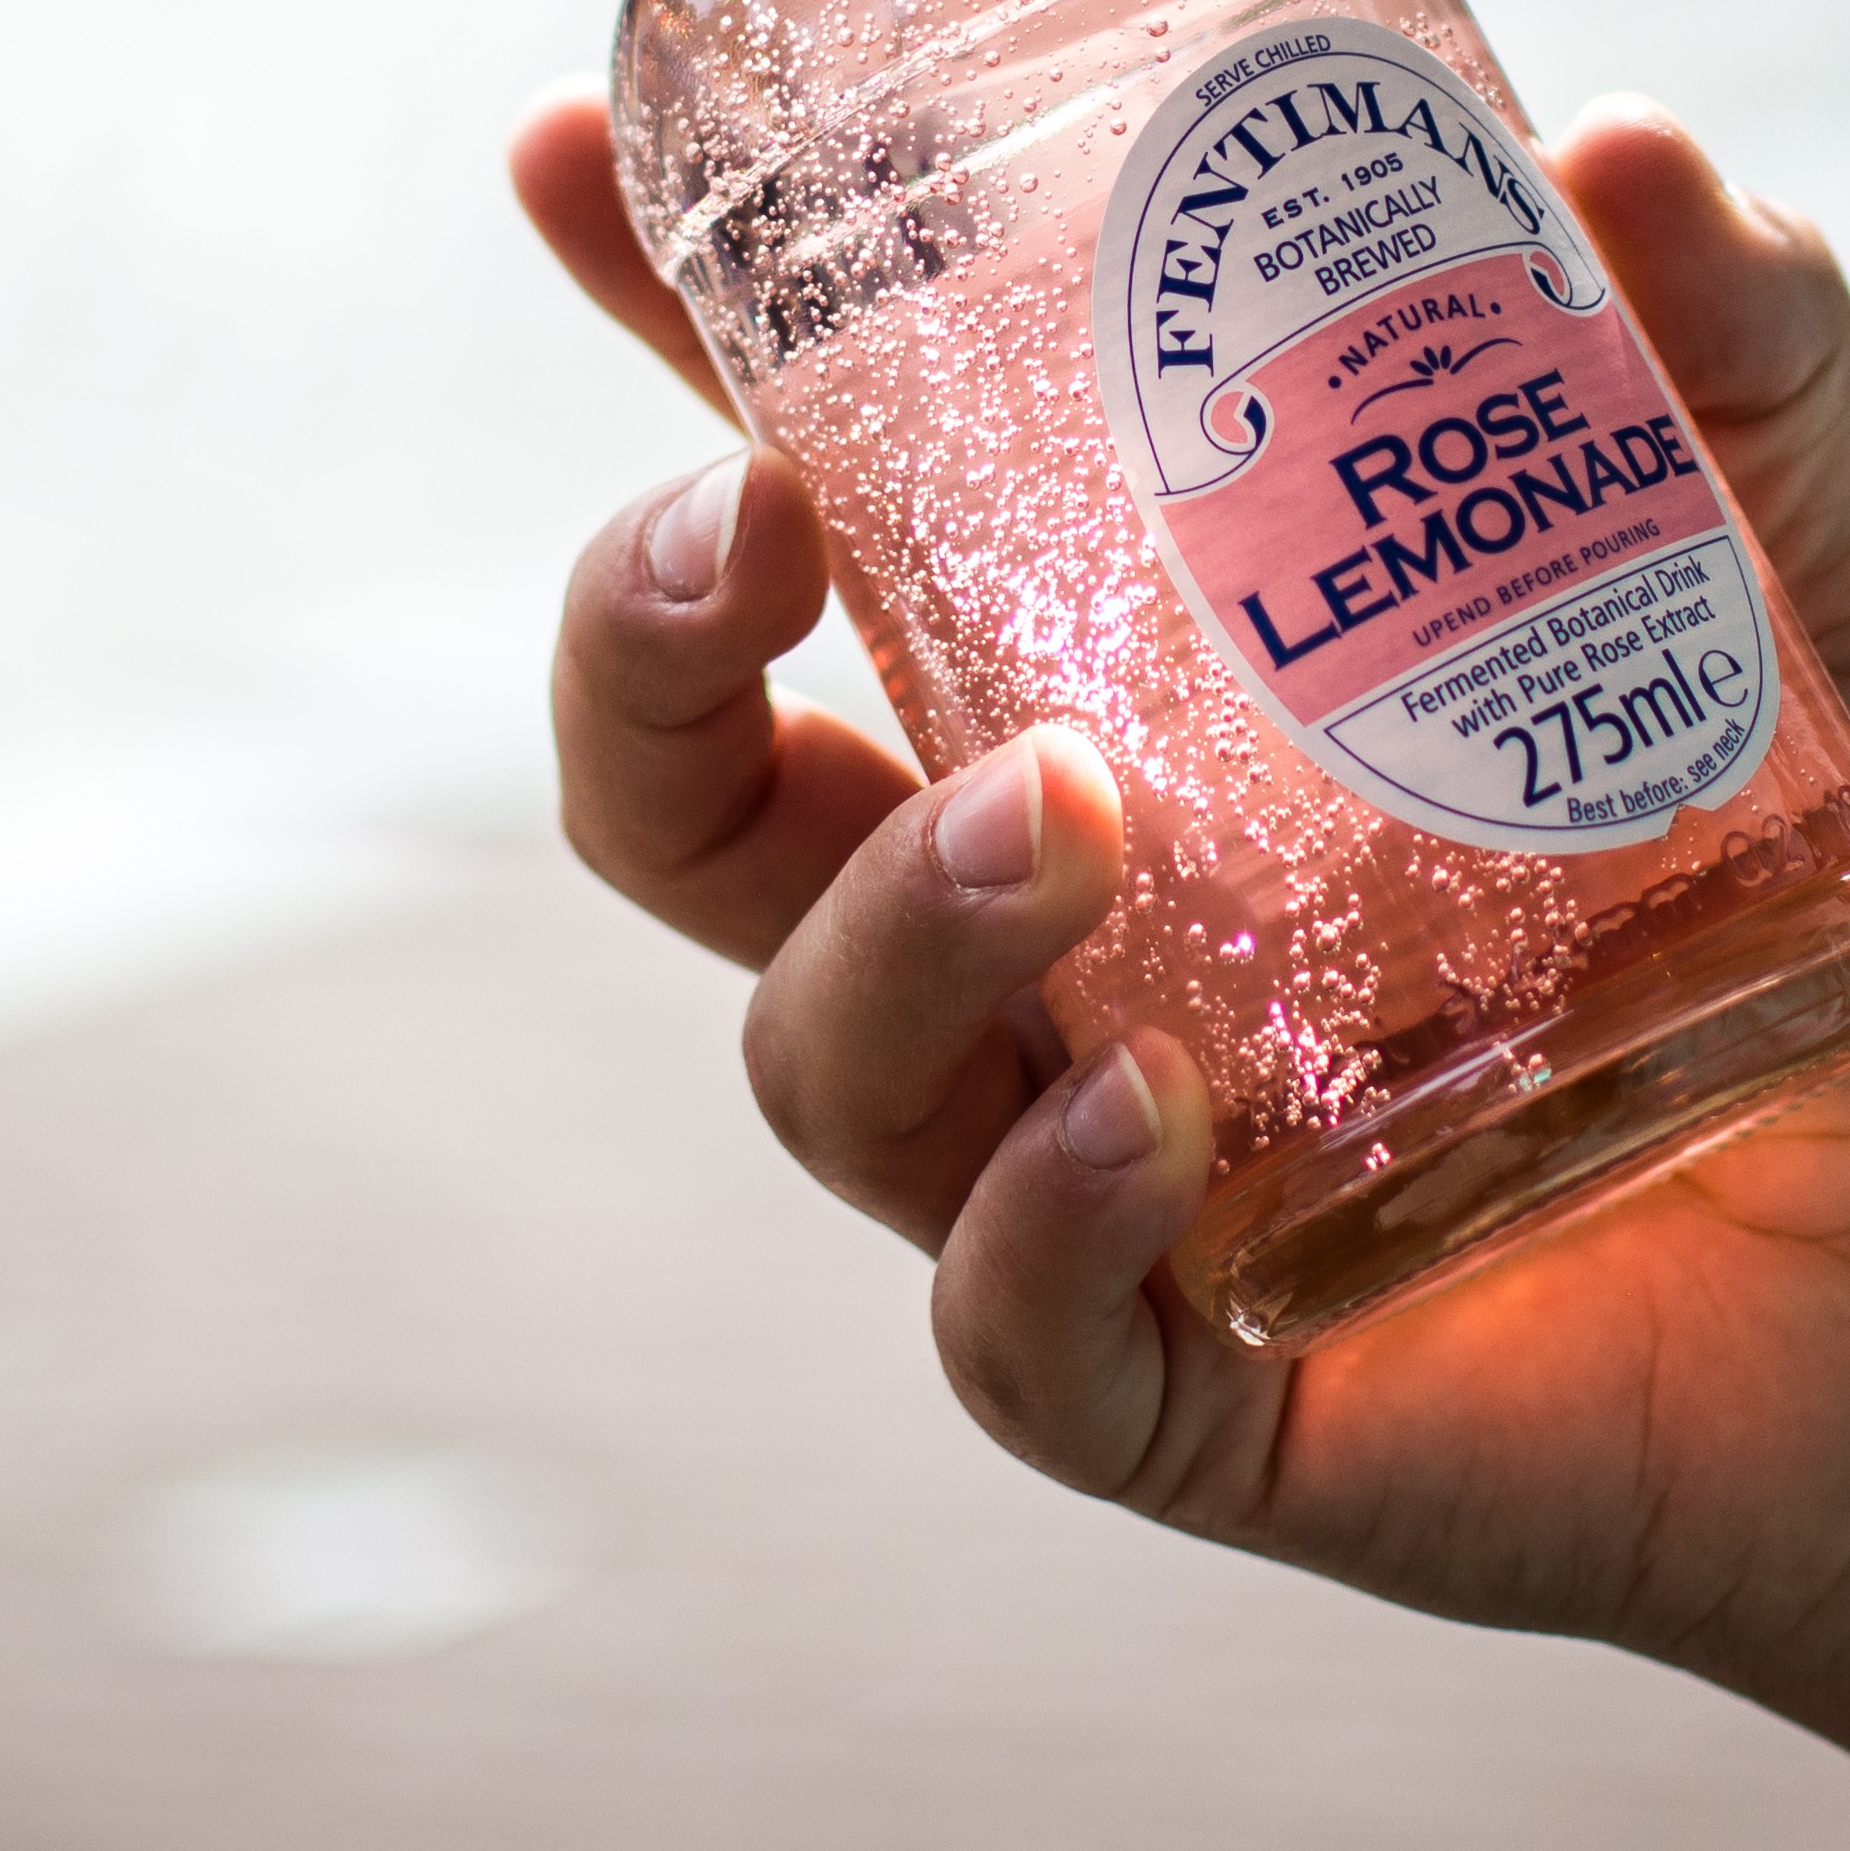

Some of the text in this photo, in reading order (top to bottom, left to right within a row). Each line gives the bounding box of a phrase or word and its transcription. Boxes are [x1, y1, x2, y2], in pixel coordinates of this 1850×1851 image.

[1195, 34, 1332, 108] SERVE CHILLED
[1156, 81, 1545, 380] FENTIMANS
[1253, 175, 1442, 283] BOTANICALLY
[1260, 152, 1404, 230] EST. 1905
[1314, 223, 1437, 296] BREWED
[1338, 293, 1486, 376] NATURAL
[1329, 368, 1591, 531] ROSE
[1238, 414, 1702, 672] LEMONADE
[1412, 518, 1661, 648] UPEND BEFORE POURING
[1400, 555, 1711, 723] Fermented Botanical Drink
[1452, 595, 1716, 738] with Pure Rose Extract
[1566, 717, 1746, 824] Best before: see neck
